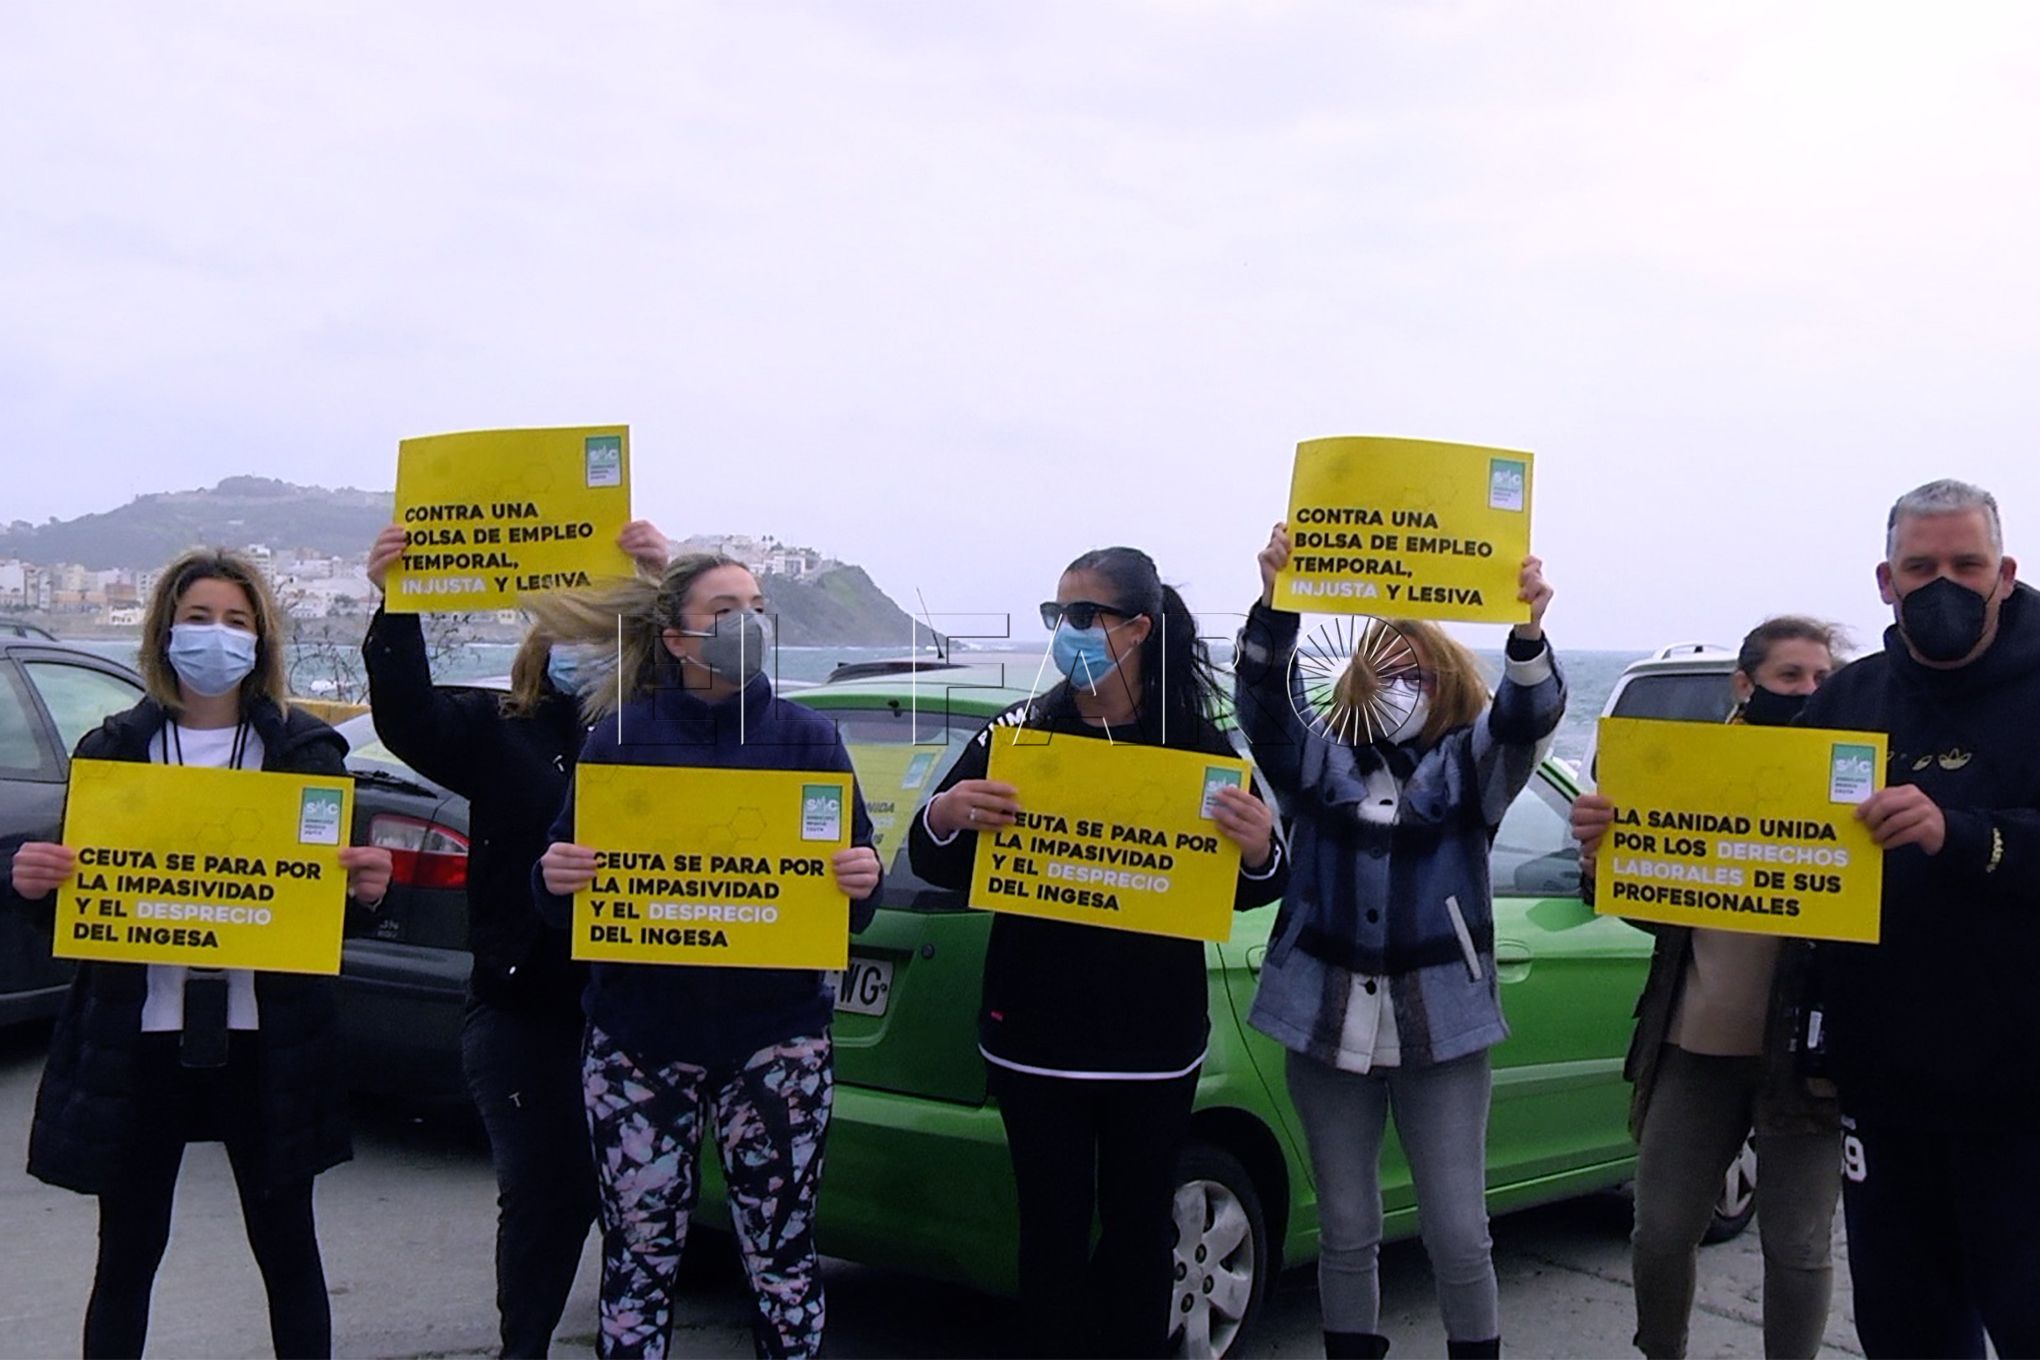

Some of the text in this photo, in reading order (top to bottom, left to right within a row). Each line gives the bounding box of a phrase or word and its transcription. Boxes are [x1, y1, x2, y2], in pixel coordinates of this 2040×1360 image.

[405, 502, 539, 523] CONTRA UNA
[1296, 508, 1439, 529] CONTRA UNA
[474, 528, 501, 544] DE
[509, 522, 593, 544] EMPLEO
[1294, 532, 1493, 558] BOLSA DE EMPLEO
[402, 552, 519, 571] TEMPORAL,
[1293, 557, 1413, 578] TEMPORAL,
[402, 571, 591, 594] INJUSTA Y LESIVA
[1291, 580, 1484, 606] INJUSTA Y LESIVA
[1011, 811, 1218, 854] EUTA SE PARA POR
[1613, 808, 1837, 841] LA SANIDAD UNIDA
[994, 832, 1173, 871] LA IMPASIVIDAD
[1614, 832, 1848, 866] POR LOS DERECHOS
[78, 847, 321, 880] CEUTA SE PARA POR
[594, 852, 825, 877] CEUTA SE PARA POR
[992, 854, 1170, 893] Y EL DESPRECIO
[1613, 858, 1841, 893] LABORALES DE SUS
[77, 873, 274, 901] LA IMPASIVIDAD
[591, 876, 780, 900] LA IMPASIVIDAD
[988, 877, 1119, 911] DEL INGESA
[1613, 882, 1800, 917] PROFESIONALES
[75, 897, 273, 926] Y EL DESPRECIO
[590, 901, 778, 924] Y EL DESPRECIO
[73, 923, 219, 948] DEL INGESA
[590, 925, 728, 948] DEL INGESA
[831, 964, 882, 1006] WG
